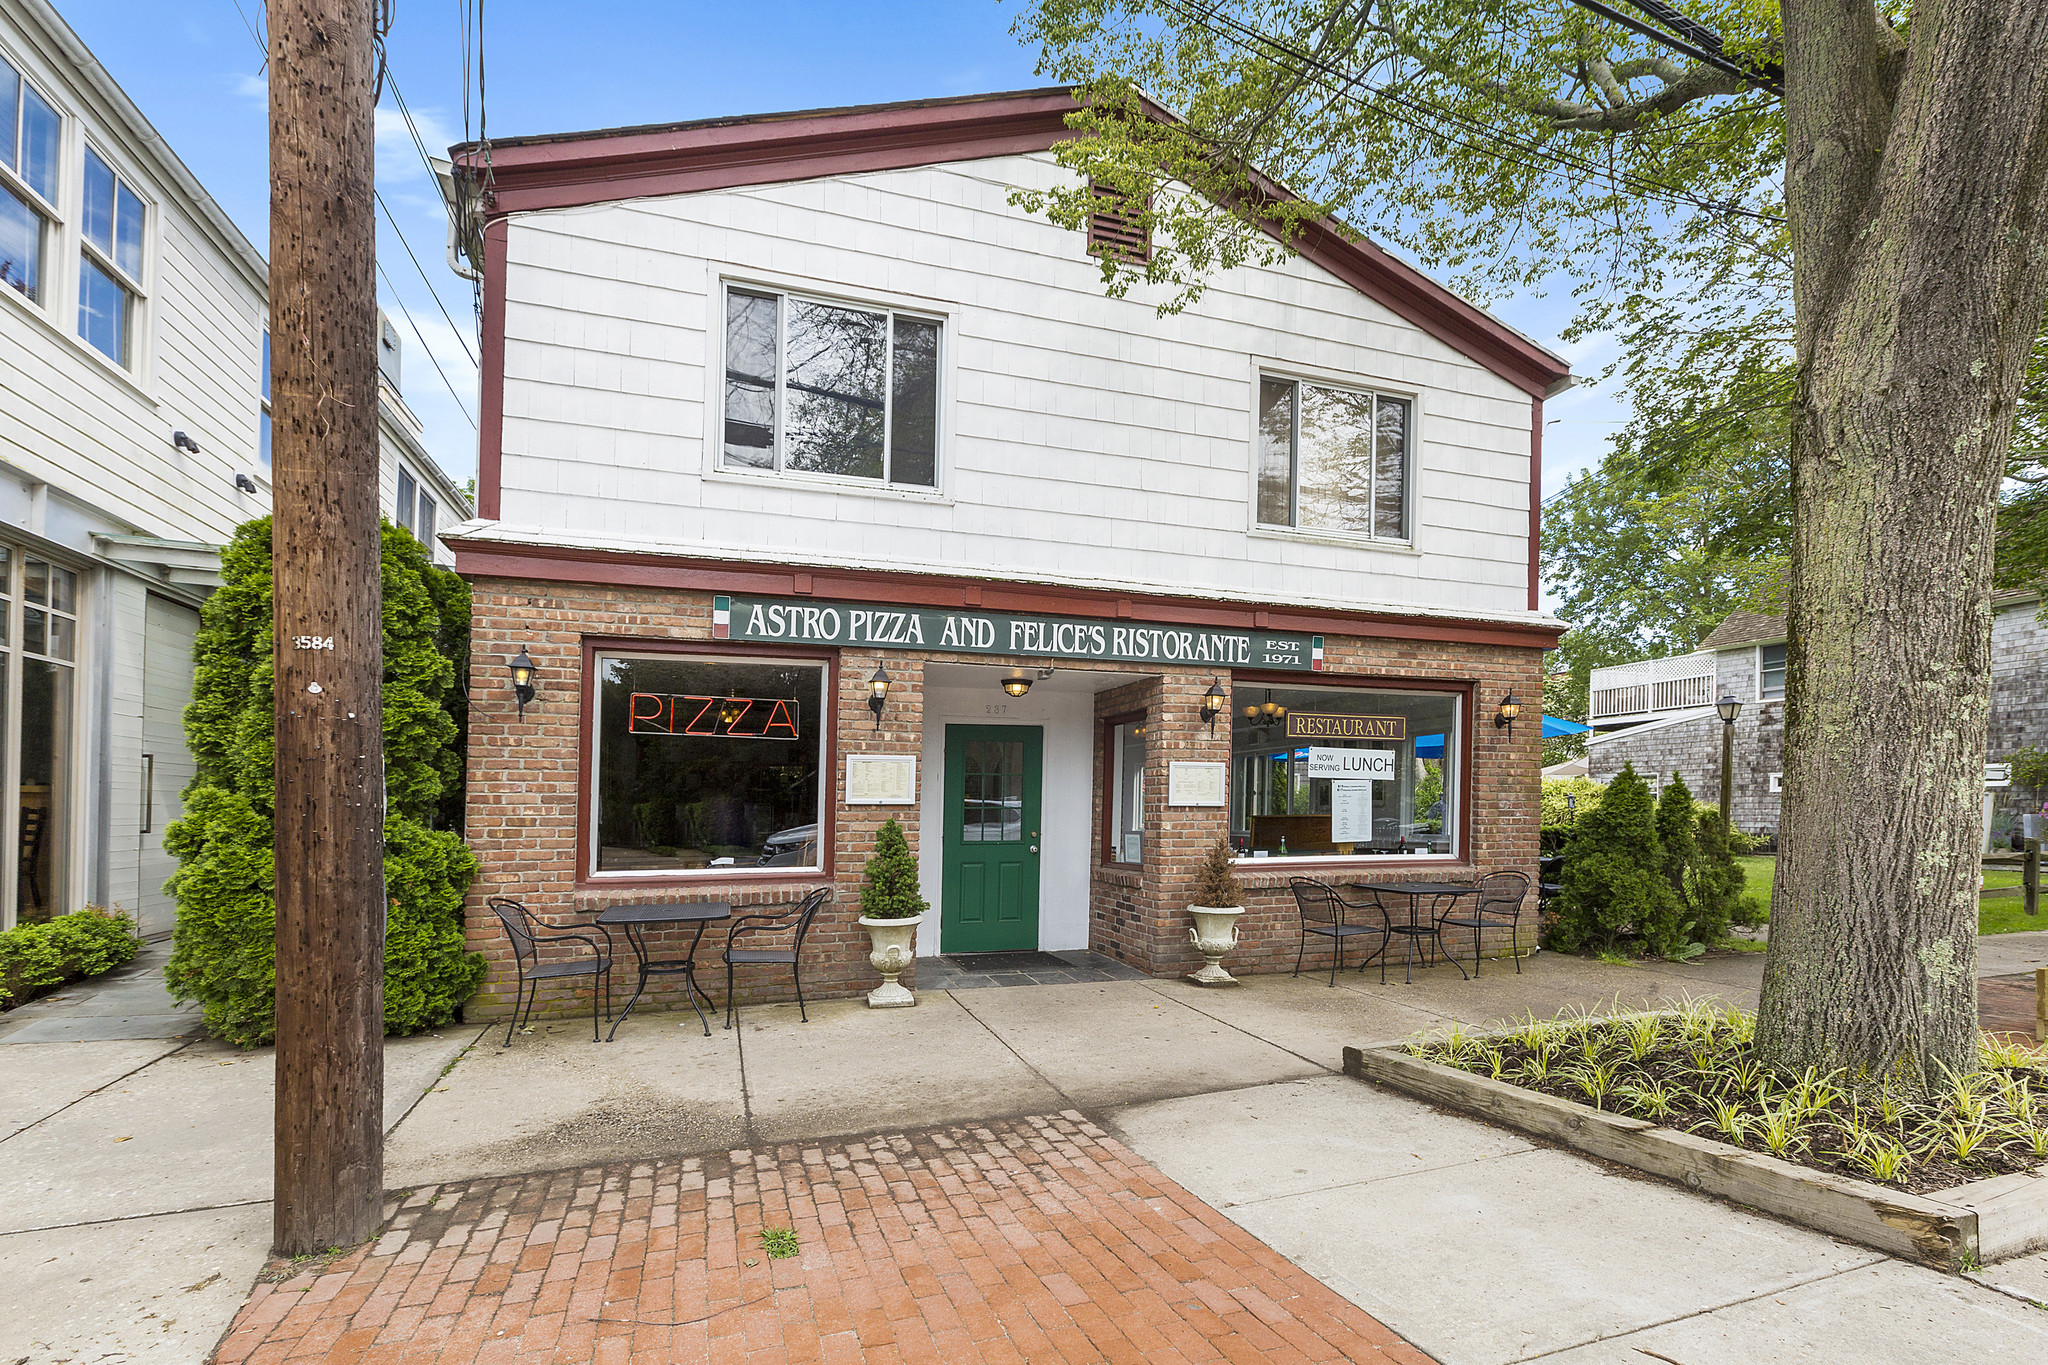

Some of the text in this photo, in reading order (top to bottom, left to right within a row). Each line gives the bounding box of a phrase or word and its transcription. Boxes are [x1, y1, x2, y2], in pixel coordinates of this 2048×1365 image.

[745, 604, 1251, 664] ASTRO PIZZA AND FELICE'S RISTORANTE
[292, 636, 334, 651] 3584
[1262, 654, 1302, 665] 1971
[630, 694, 798, 737] PIZZA
[985, 704, 1007, 714] 237
[1295, 716, 1397, 737] RESTAURANT
[1316, 754, 1335, 762] NOW
[1343, 757, 1394, 772] LUNCH
[1309, 763, 1341, 772] SERVING
